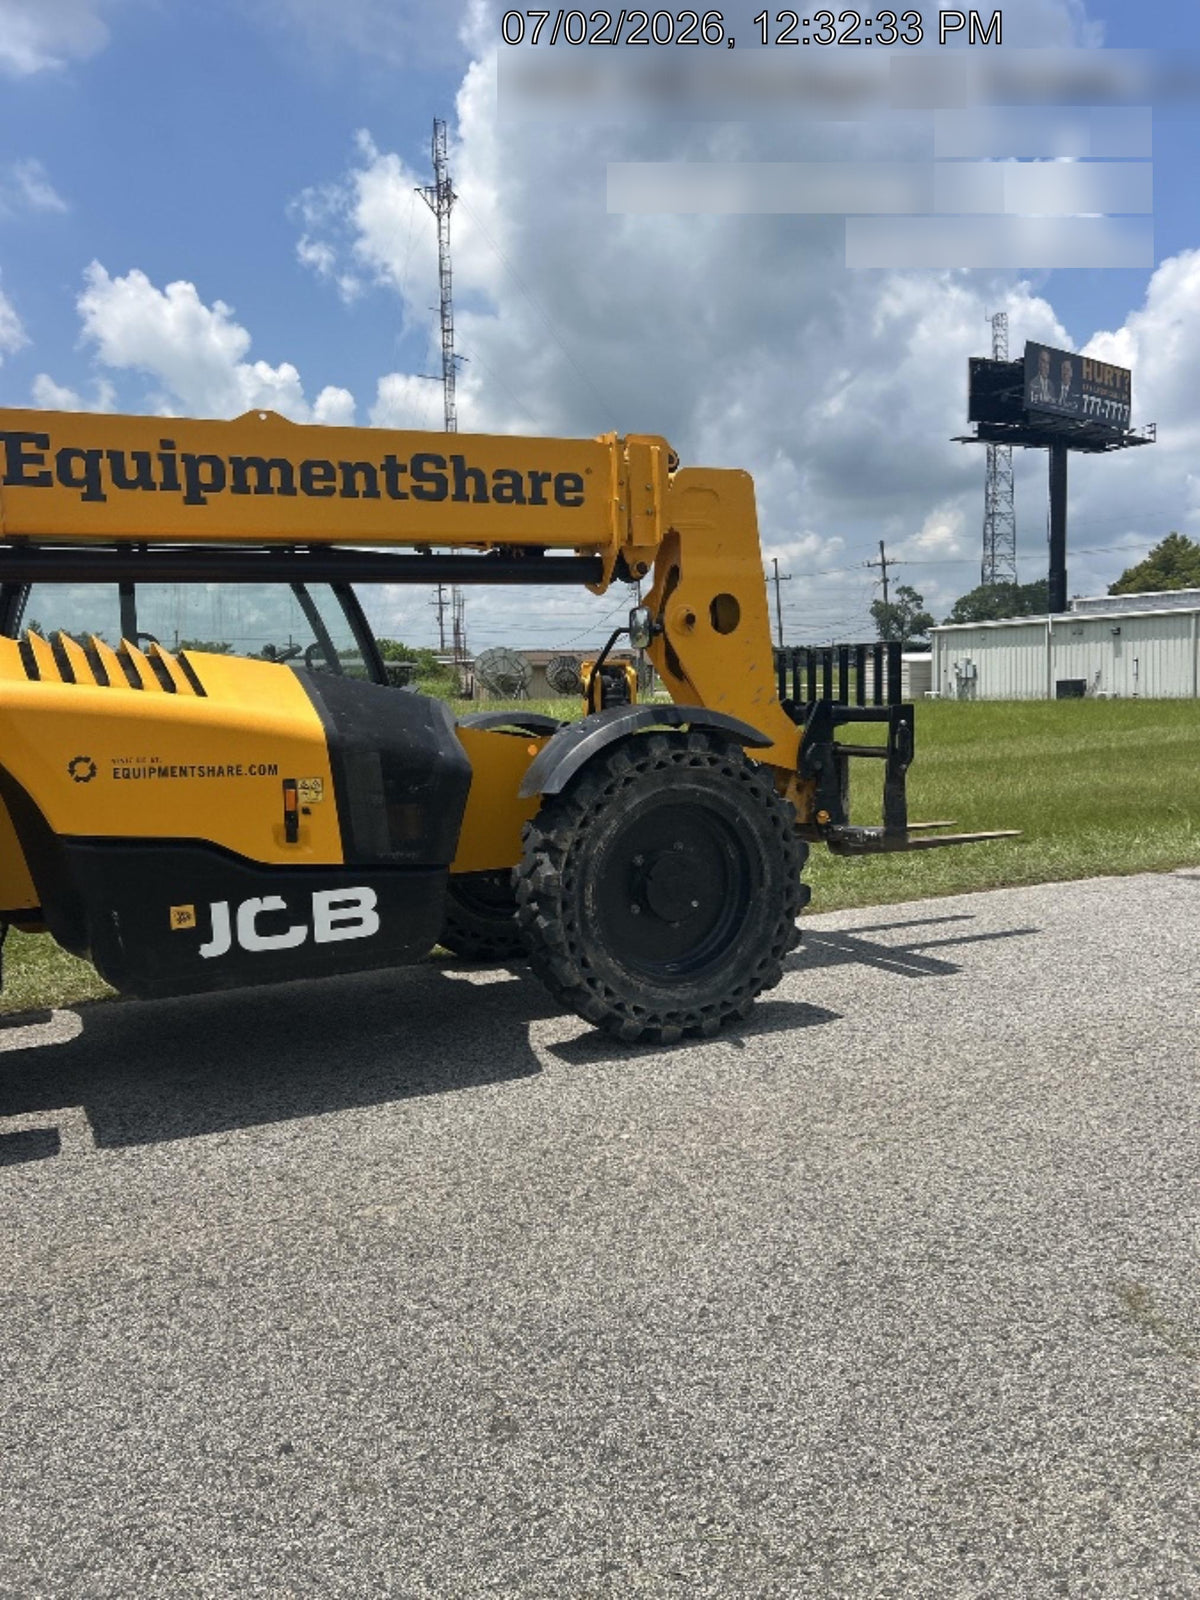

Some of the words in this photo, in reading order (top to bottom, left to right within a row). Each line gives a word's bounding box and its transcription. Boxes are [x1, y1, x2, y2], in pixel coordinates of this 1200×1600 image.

[1082, 359, 1129, 392] HURT?
[0, 431, 586, 507] EquipmentShare
[112, 764, 279, 780] EQUIPMENTSHARE.COM
[198, 886, 380, 959] JCB
